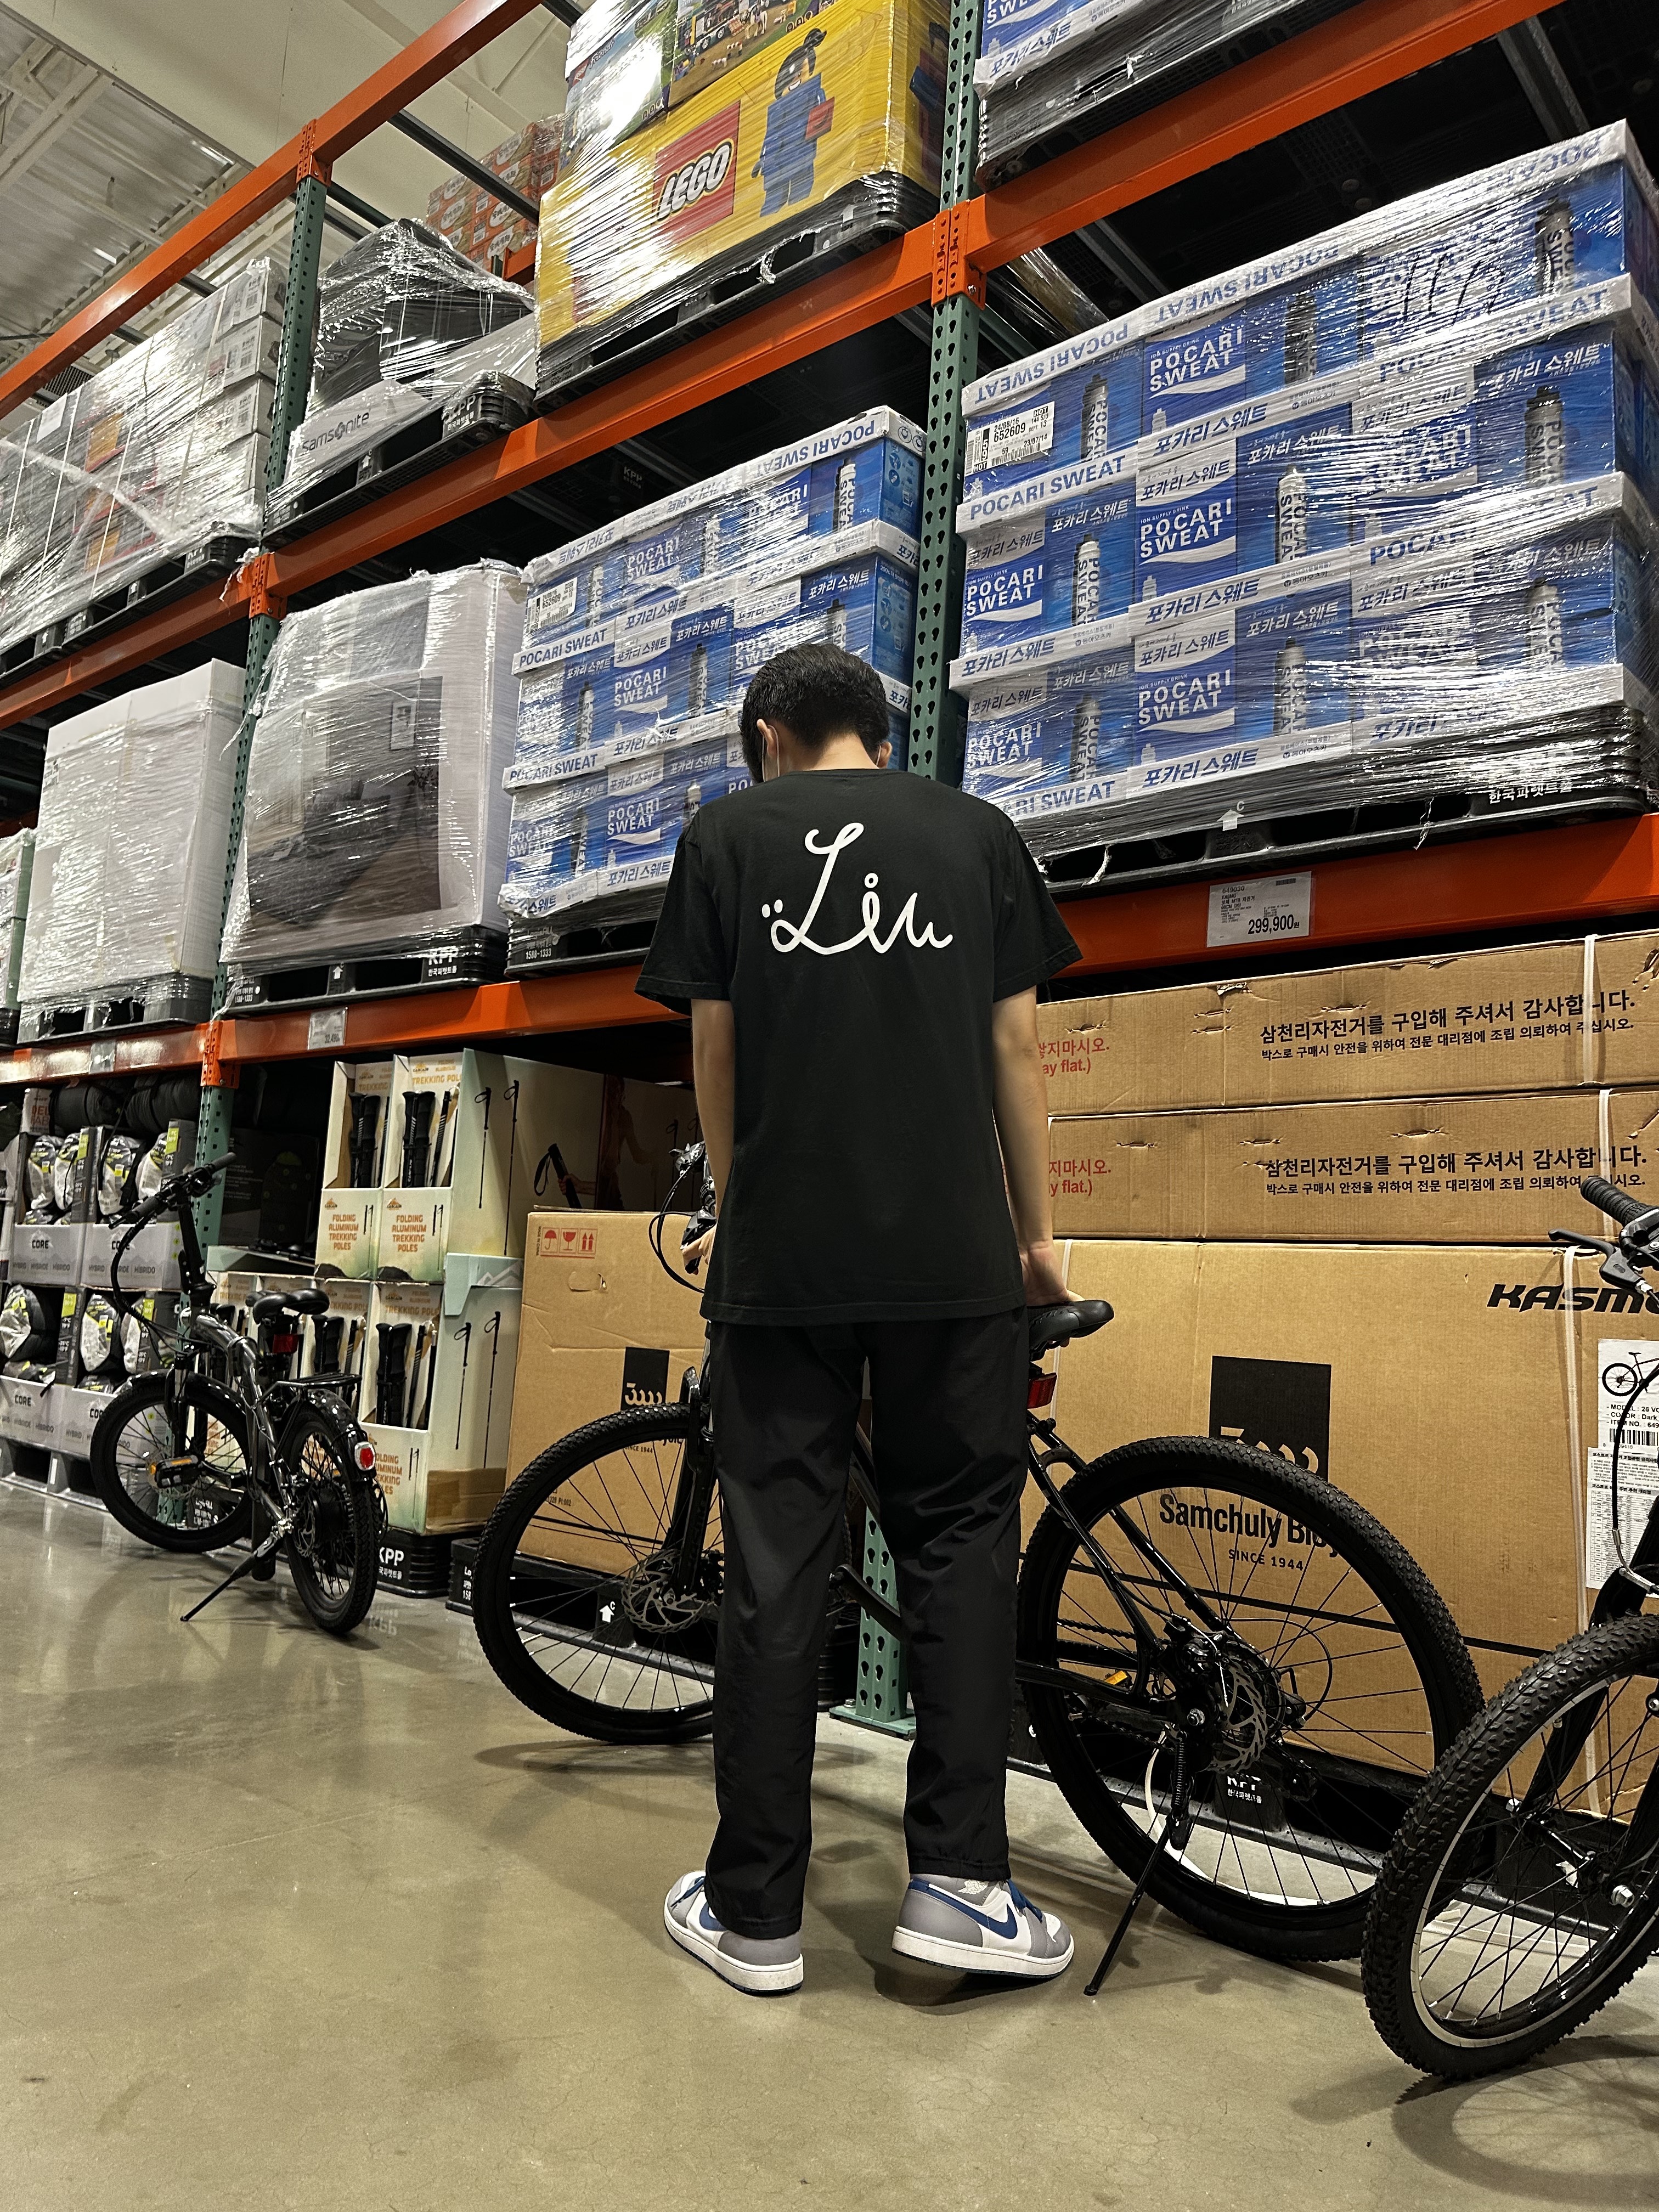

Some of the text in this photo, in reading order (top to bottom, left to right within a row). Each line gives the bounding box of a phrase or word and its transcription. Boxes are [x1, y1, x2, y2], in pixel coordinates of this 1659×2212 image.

[658, 142, 732, 219] LEGO
[1158, 279, 1238, 323] SWEAT
[975, 323, 1128, 404] POCARI SWEAT
[1150, 327, 1243, 376] POCARI
[1547, 345, 1601, 372] 스웨트
[1149, 349, 1234, 392] SWEAT
[1034, 406, 1048, 416] HOT
[994, 417, 1019, 432] 24/08/16
[994, 422, 1026, 442] 652609
[1041, 420, 1047, 428] 13
[1153, 421, 1210, 456] 포카리
[1211, 403, 1268, 438] 스웨트
[812, 420, 875, 456] POCARI
[1024, 433, 1047, 447] 23/07/14
[1247, 439, 1291, 466] 포카리
[974, 462, 987, 472] HOT
[970, 482, 1044, 521] POCARI
[1050, 455, 1126, 493] SWEAT
[1141, 474, 1184, 501] 포카리
[1186, 460, 1231, 483] 스웨트
[1051, 511, 1088, 533] 포카리
[1090, 500, 1129, 521] 스웨트
[1141, 498, 1232, 541] POCARI
[1152, 510, 1171, 521] SUPPLY
[1173, 505, 1189, 515] DRINK
[1007, 529, 1043, 554] 스웨트
[1140, 520, 1223, 558] SWEAT
[808, 569, 870, 600] 포카리 스웨트
[967, 565, 1043, 601] POCARI
[966, 583, 1035, 617] SWEAT
[1144, 578, 1261, 625] 포카리 스웨트
[625, 608, 657, 630] 포카리
[675, 616, 728, 642] 포카리 스웨트
[1245, 612, 1289, 638] 포카리
[1292, 602, 1339, 627] 스웨트
[520, 629, 608, 668] POCARI SWEAT
[641, 636, 668, 655] 스웨트
[962, 637, 1056, 677] 포카리 스웨트
[1138, 642, 1182, 668] 포카리
[1184, 629, 1229, 654] 스웨트
[566, 658, 612, 680] 포카리 스웨트
[614, 667, 667, 694] POCARI
[1052, 671, 1086, 691] 포카리
[1150, 677, 1170, 689] SUPPLY
[1171, 674, 1188, 682] DRINK
[614, 681, 660, 707] SWEAT
[1138, 669, 1231, 709] POCARI
[970, 694, 1003, 715] 포카리
[1138, 690, 1223, 726] SWEAT
[614, 740, 645, 755] 포카리
[554, 754, 599, 775] SWEAT
[1141, 748, 1260, 789] 포카리 스웨트
[1040, 781, 1116, 811] SWEAT
[1488, 781, 1573, 804] 한국파렛트풀
[607, 798, 659, 822] POCARI
[606, 814, 654, 836] SWEAT
[607, 860, 671, 887] 포카리 스웨트
[1260, 990, 1635, 1044] 삼천리자전거를 구입해 주셔서 감사합니다.
[1262, 1048, 1293, 1060] 박스로
[1297, 1045, 1329, 1059] 구매시
[1334, 1042, 1368, 1055] 안전을
[1372, 1037, 1406, 1052] 위하여
[1409, 1035, 1434, 1048] 전문
[1437, 1030, 1486, 1046] 대리점에
[1490, 1028, 1515, 1041] 조립
[1520, 1023, 1571, 1039] 의뢰하여
[412, 1075, 444, 1085] TREKKING
[1042, 1058, 1091, 1077] ay flat.)
[1049, 1159, 1111, 1178] 지마시오.
[1266, 1145, 1647, 1178] 삼천리자전거를 구입해 주셔서 감사합니다.
[1062, 1179, 1092, 1196] flat.)
[1267, 1175, 1582, 1195] 박스로 구매시 안전을 위하여 전문 대리점에 조립 의뢰하여
[329, 1223, 359, 1232] ALUMINUM
[392, 1224, 427, 1233] ALUMINUM
[396, 1214, 424, 1222] FOLDING
[32, 1240, 49, 1249] CORE
[111, 1240, 130, 1250] COE
[330, 1233, 357, 1241] TREKKING
[334, 1242, 351, 1250] POLES
[385, 1306, 419, 1314] TREKKING
[15, 1395, 31, 1407] CORE
[1159, 1493, 1282, 1548] Samchuly
[1228, 1549, 1304, 1571] SINCE 1944
